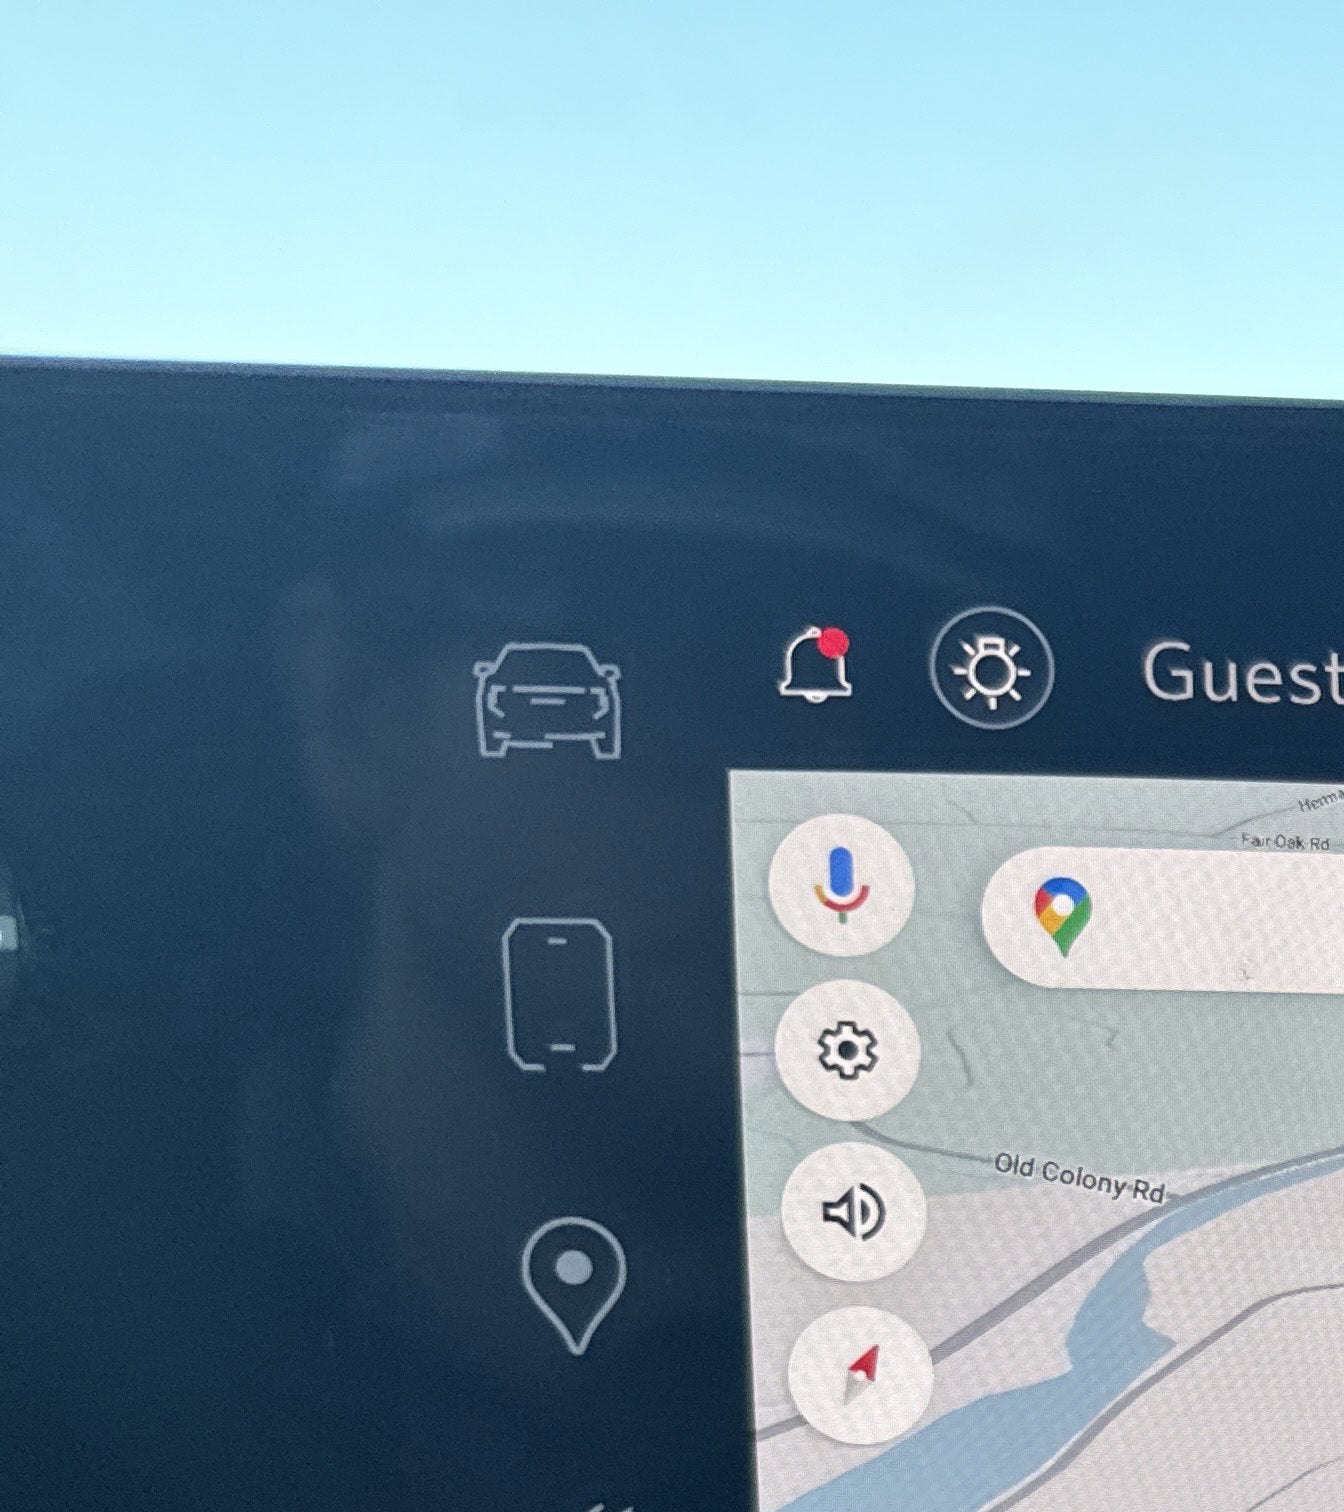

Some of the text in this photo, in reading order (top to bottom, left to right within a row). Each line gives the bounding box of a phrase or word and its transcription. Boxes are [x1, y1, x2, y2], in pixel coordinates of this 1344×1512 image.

[1275, 834, 1305, 850] Oak
[1310, 837, 1330, 851] Rd
[994, 1152, 1166, 1204] Old Colony Rd
